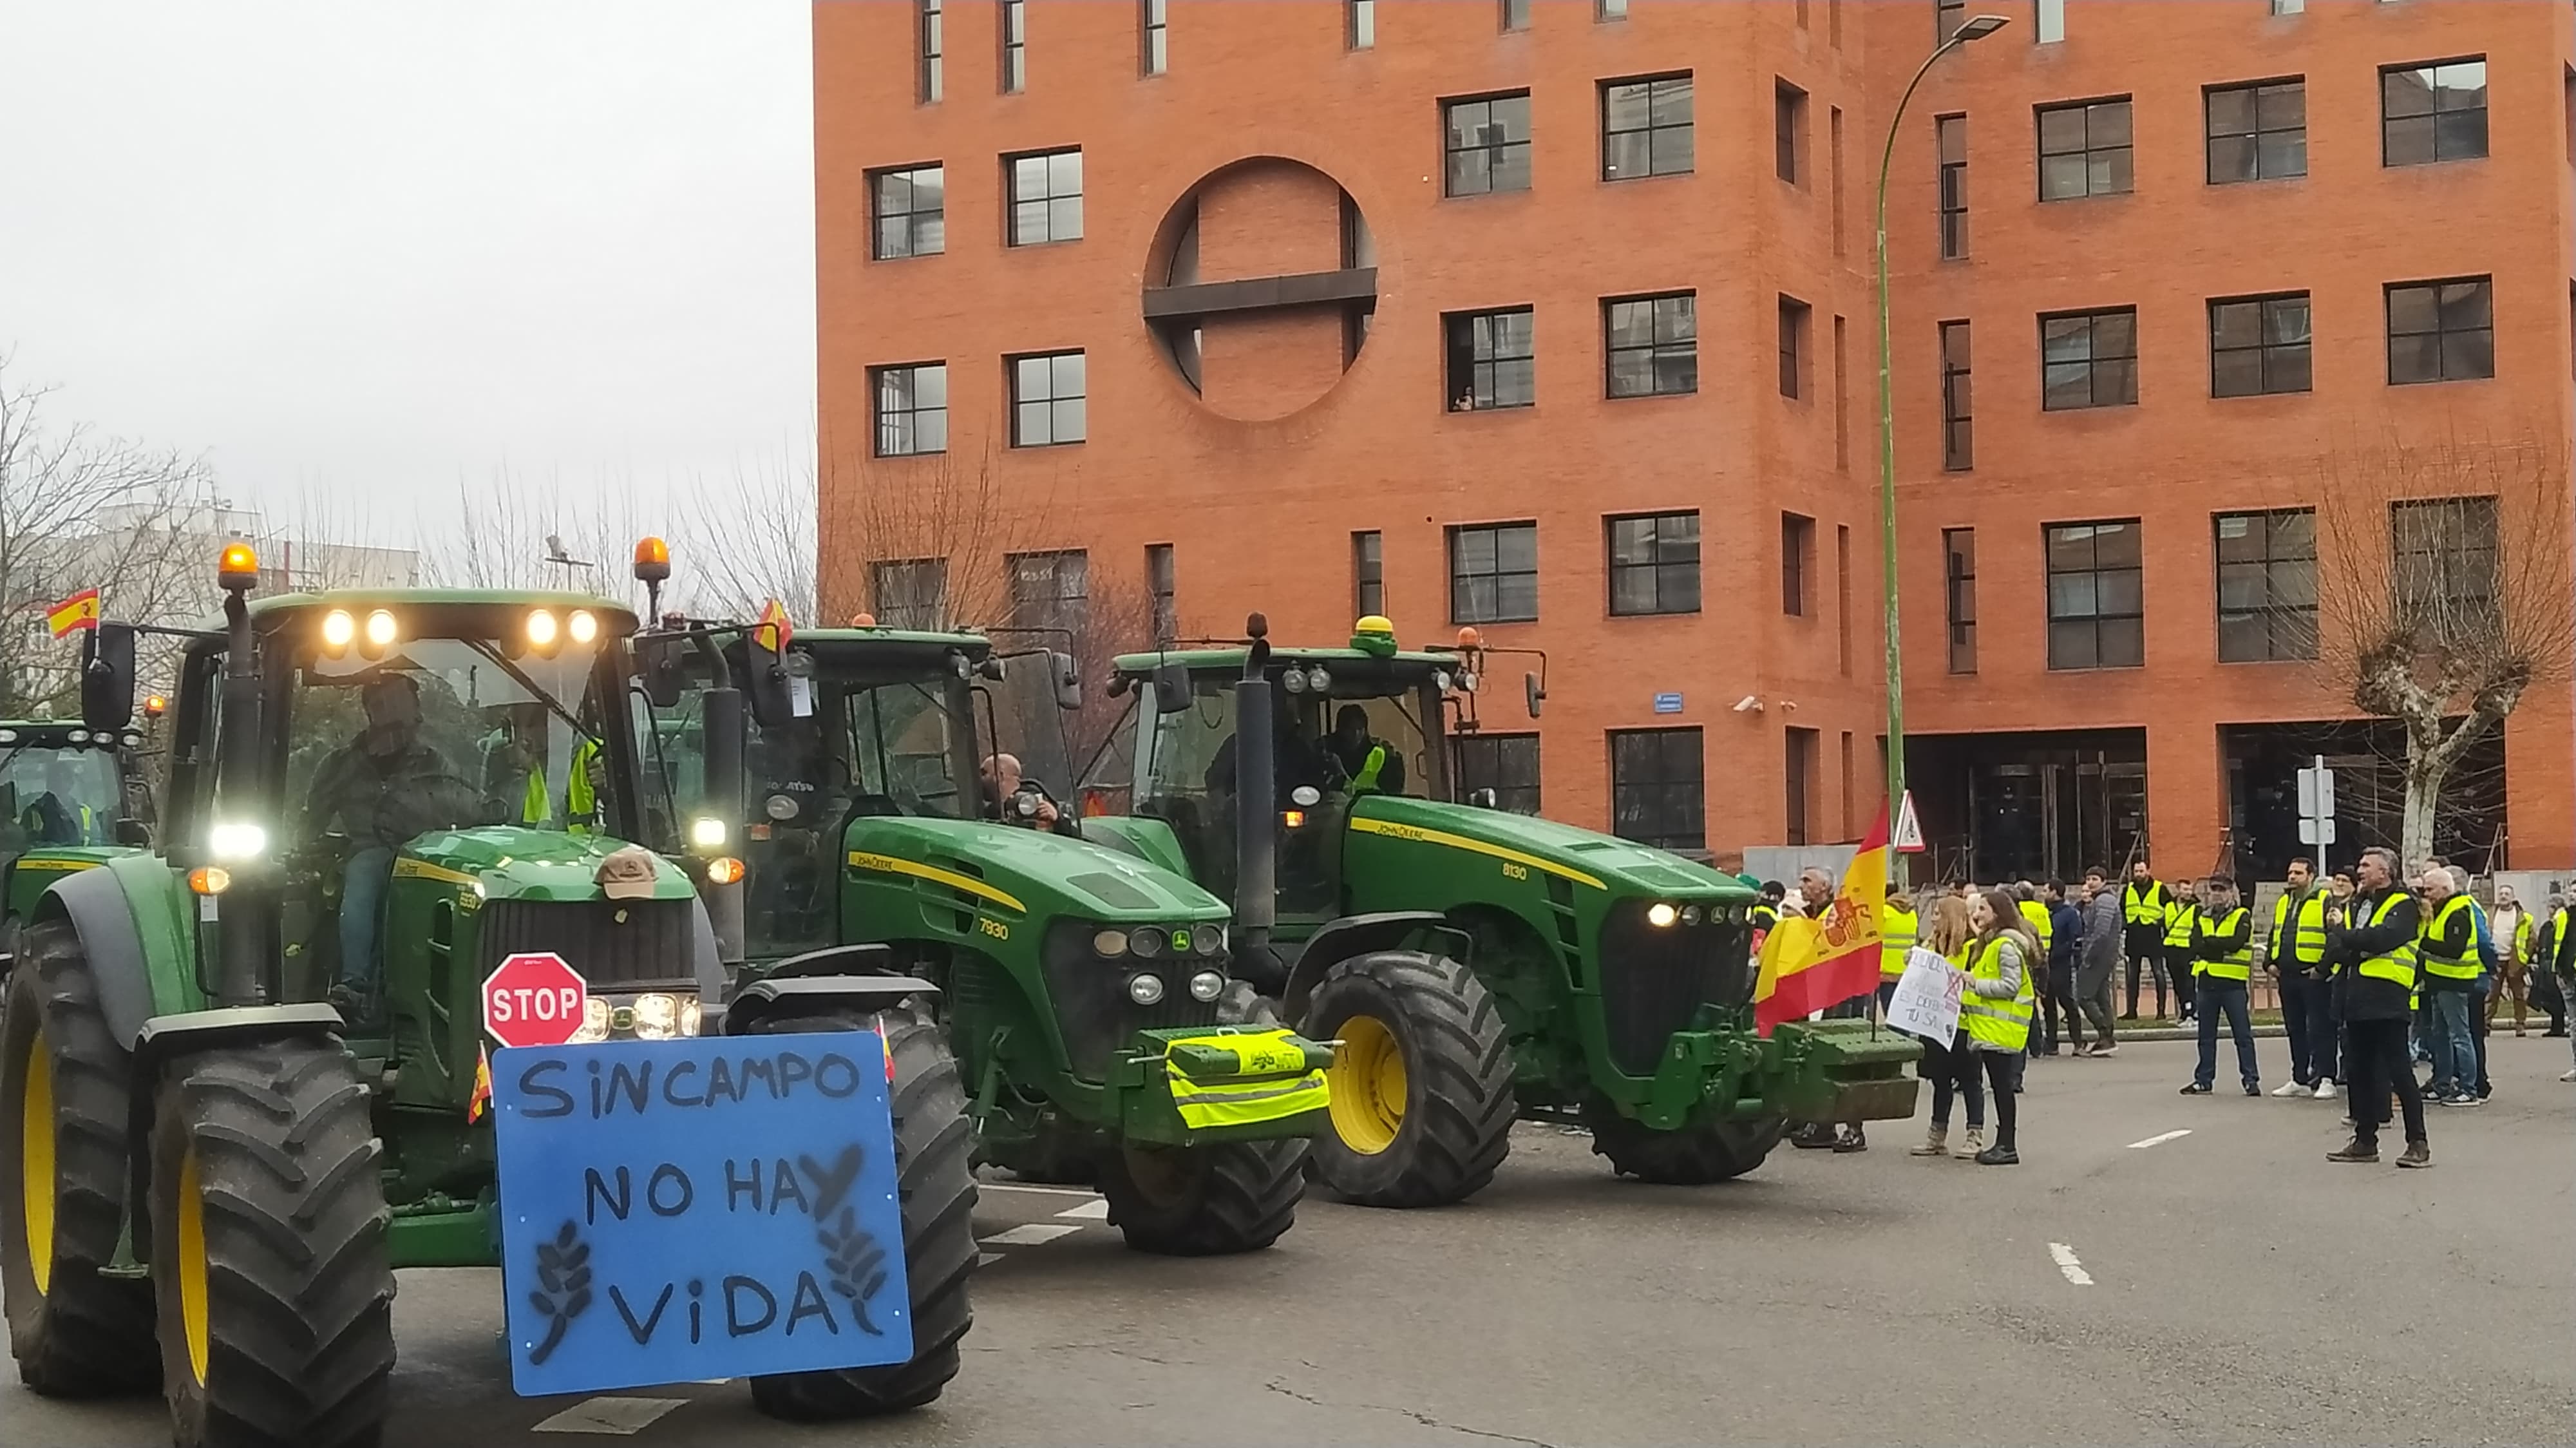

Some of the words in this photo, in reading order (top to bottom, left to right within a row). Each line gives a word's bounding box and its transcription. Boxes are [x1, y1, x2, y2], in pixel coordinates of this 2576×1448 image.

[1502, 862, 1527, 881] 8130
[980, 917, 1009, 940] 7930
[493, 987, 578, 1022] STOP
[663, 1052, 860, 1107] CAMPO
[584, 1163, 694, 1226] NO
[724, 1143, 865, 1223] HAY
